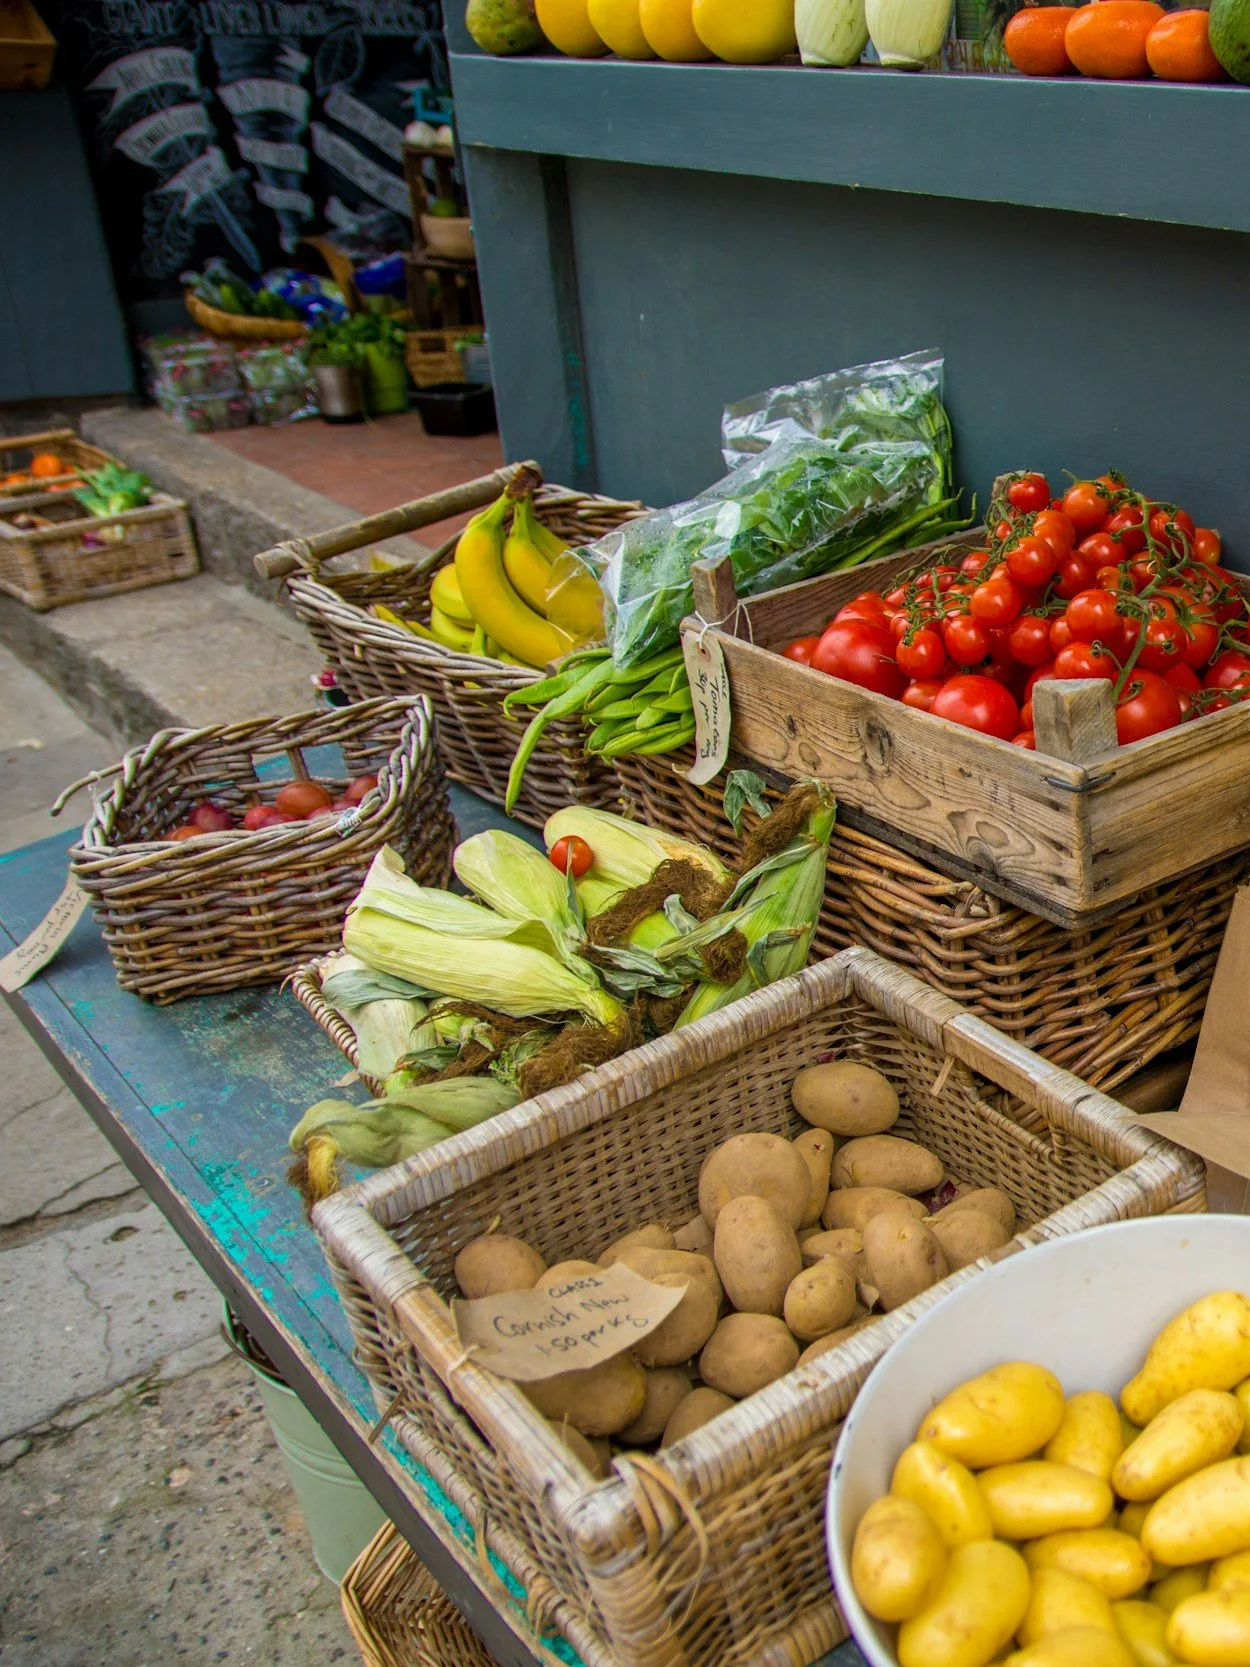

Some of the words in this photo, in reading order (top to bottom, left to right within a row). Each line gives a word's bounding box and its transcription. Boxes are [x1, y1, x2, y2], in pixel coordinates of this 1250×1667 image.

[493, 1305, 580, 1338] Cornish
[579, 1294, 630, 1312] New
[581, 1324, 605, 1348] per
